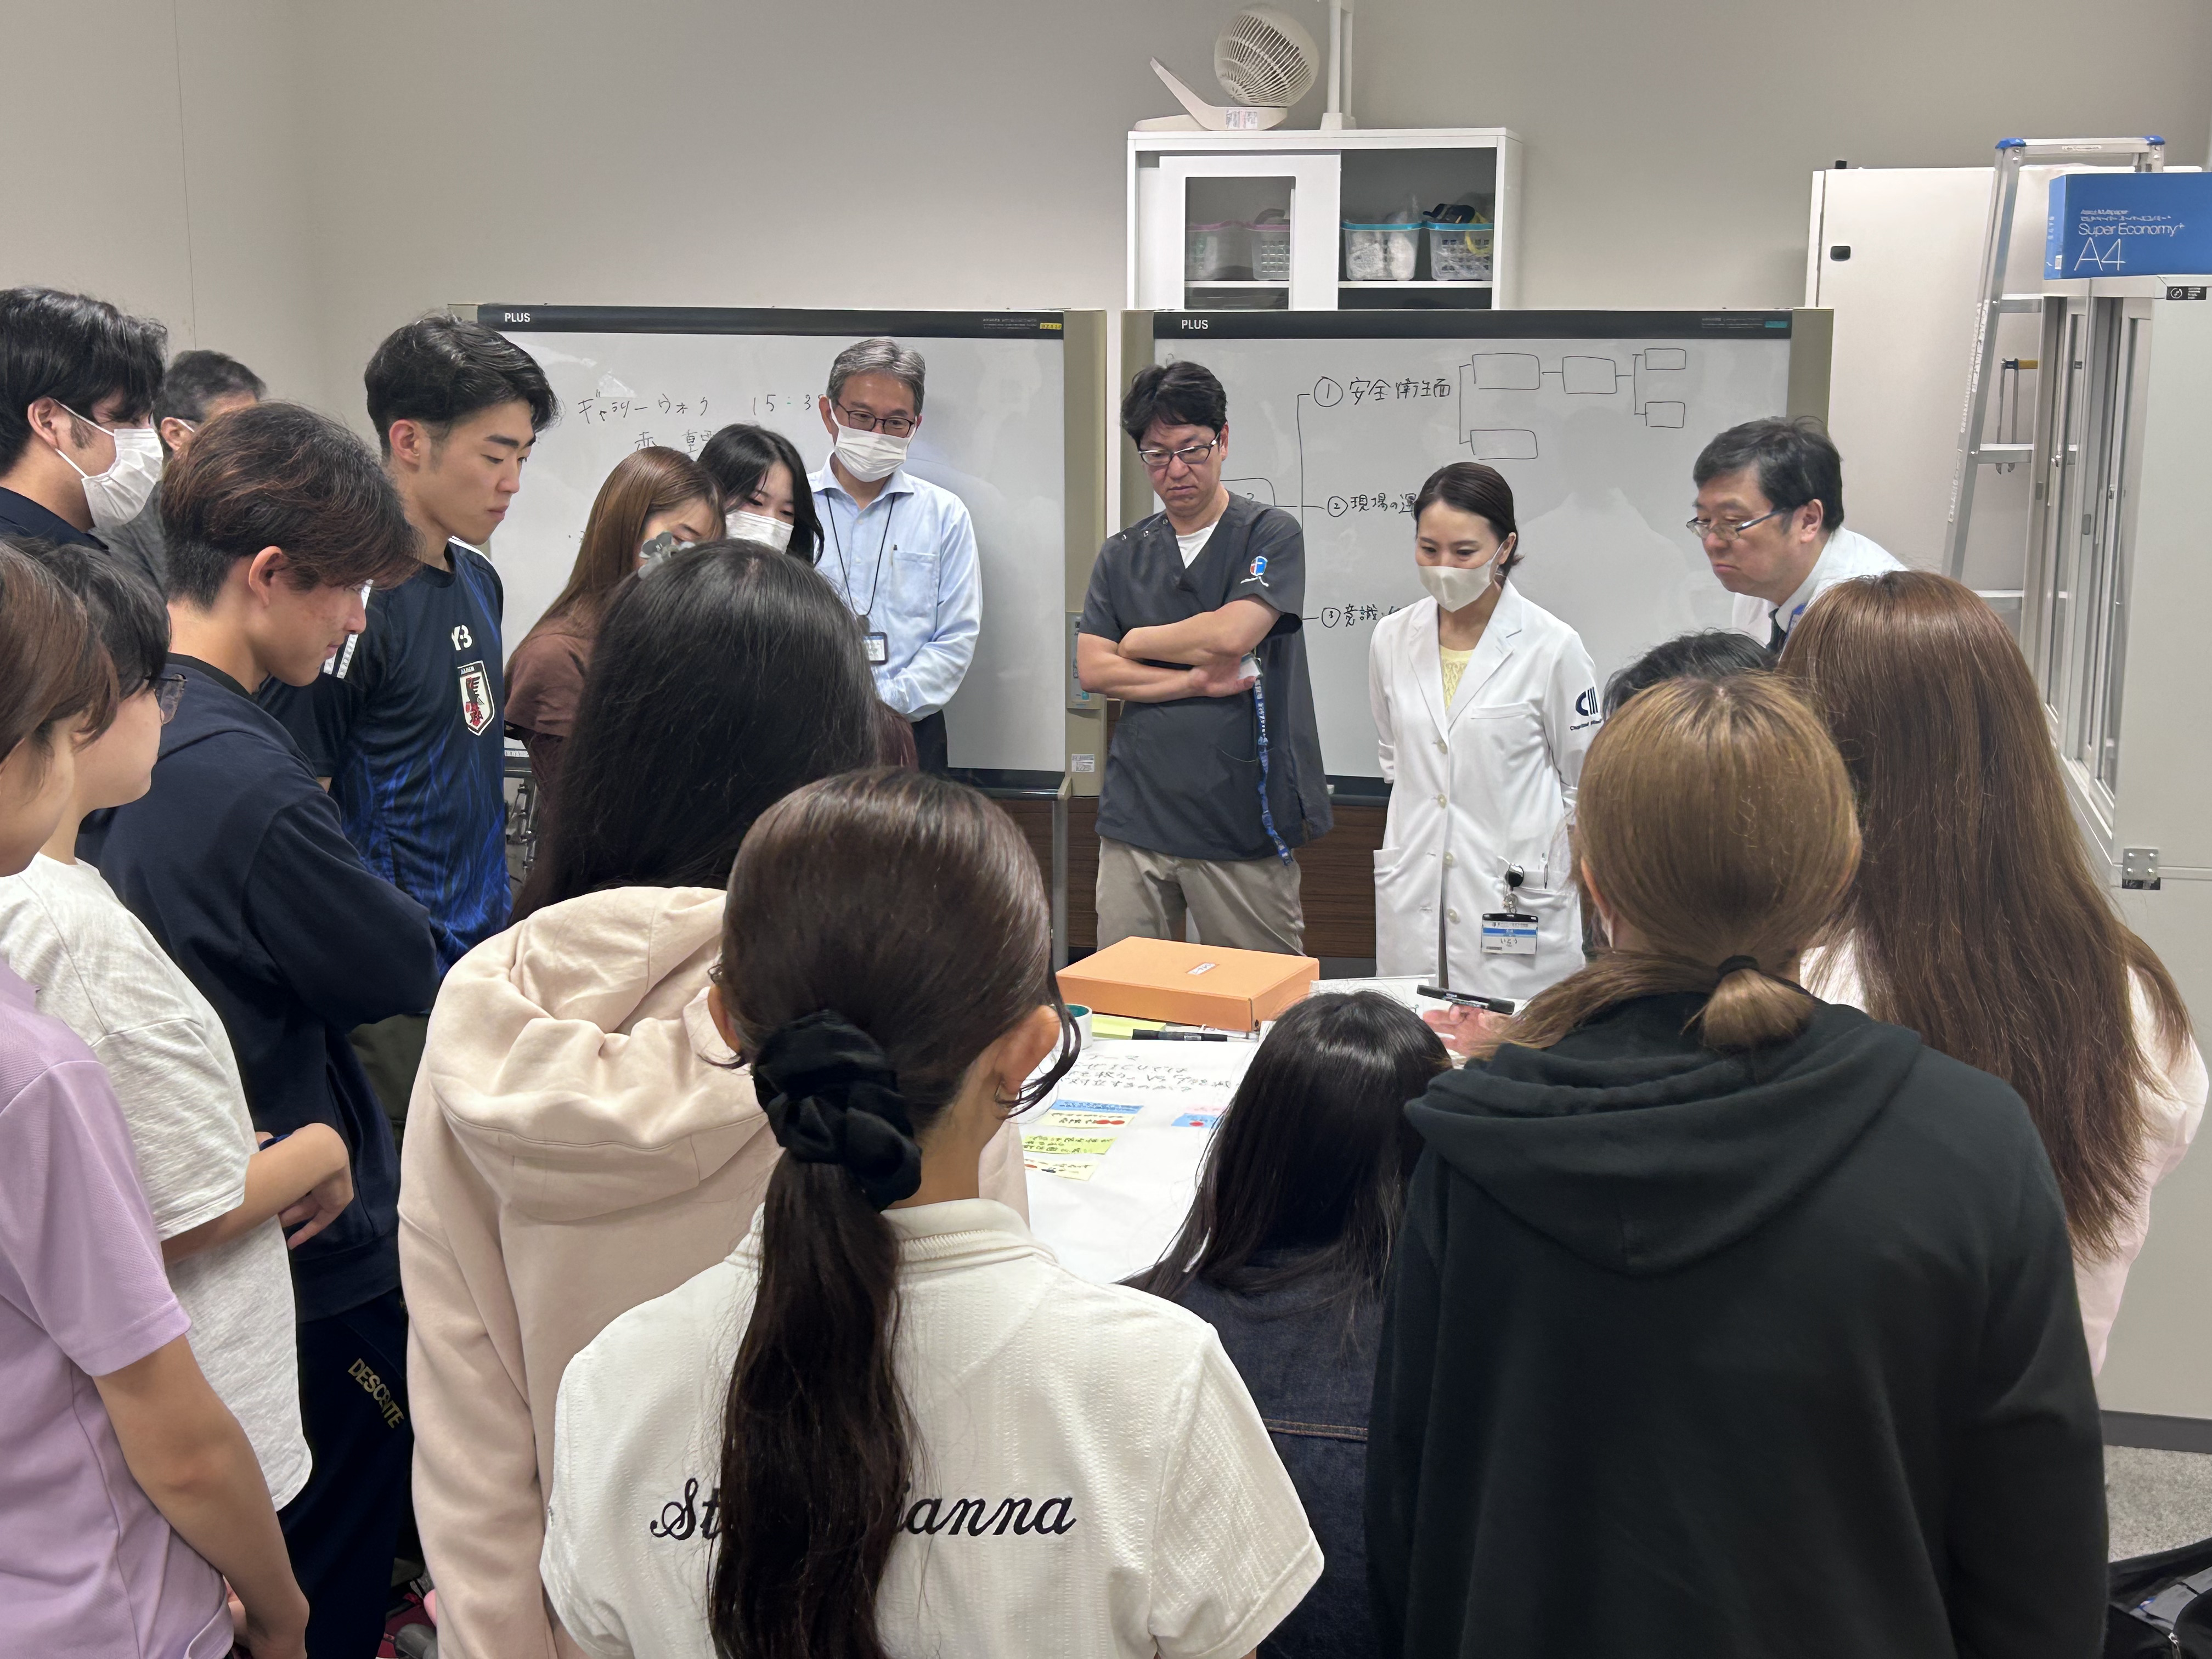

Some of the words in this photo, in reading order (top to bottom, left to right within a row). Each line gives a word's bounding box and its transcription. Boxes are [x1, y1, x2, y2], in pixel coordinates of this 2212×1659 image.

[2078, 222, 2117, 237] Super
[2074, 236, 2126, 271] A4
[505, 312, 531, 323] PLUS
[1181, 319, 1209, 330] PLUS
[753, 394, 826, 416] 15:3
[900, 1497, 1077, 1537] anna
